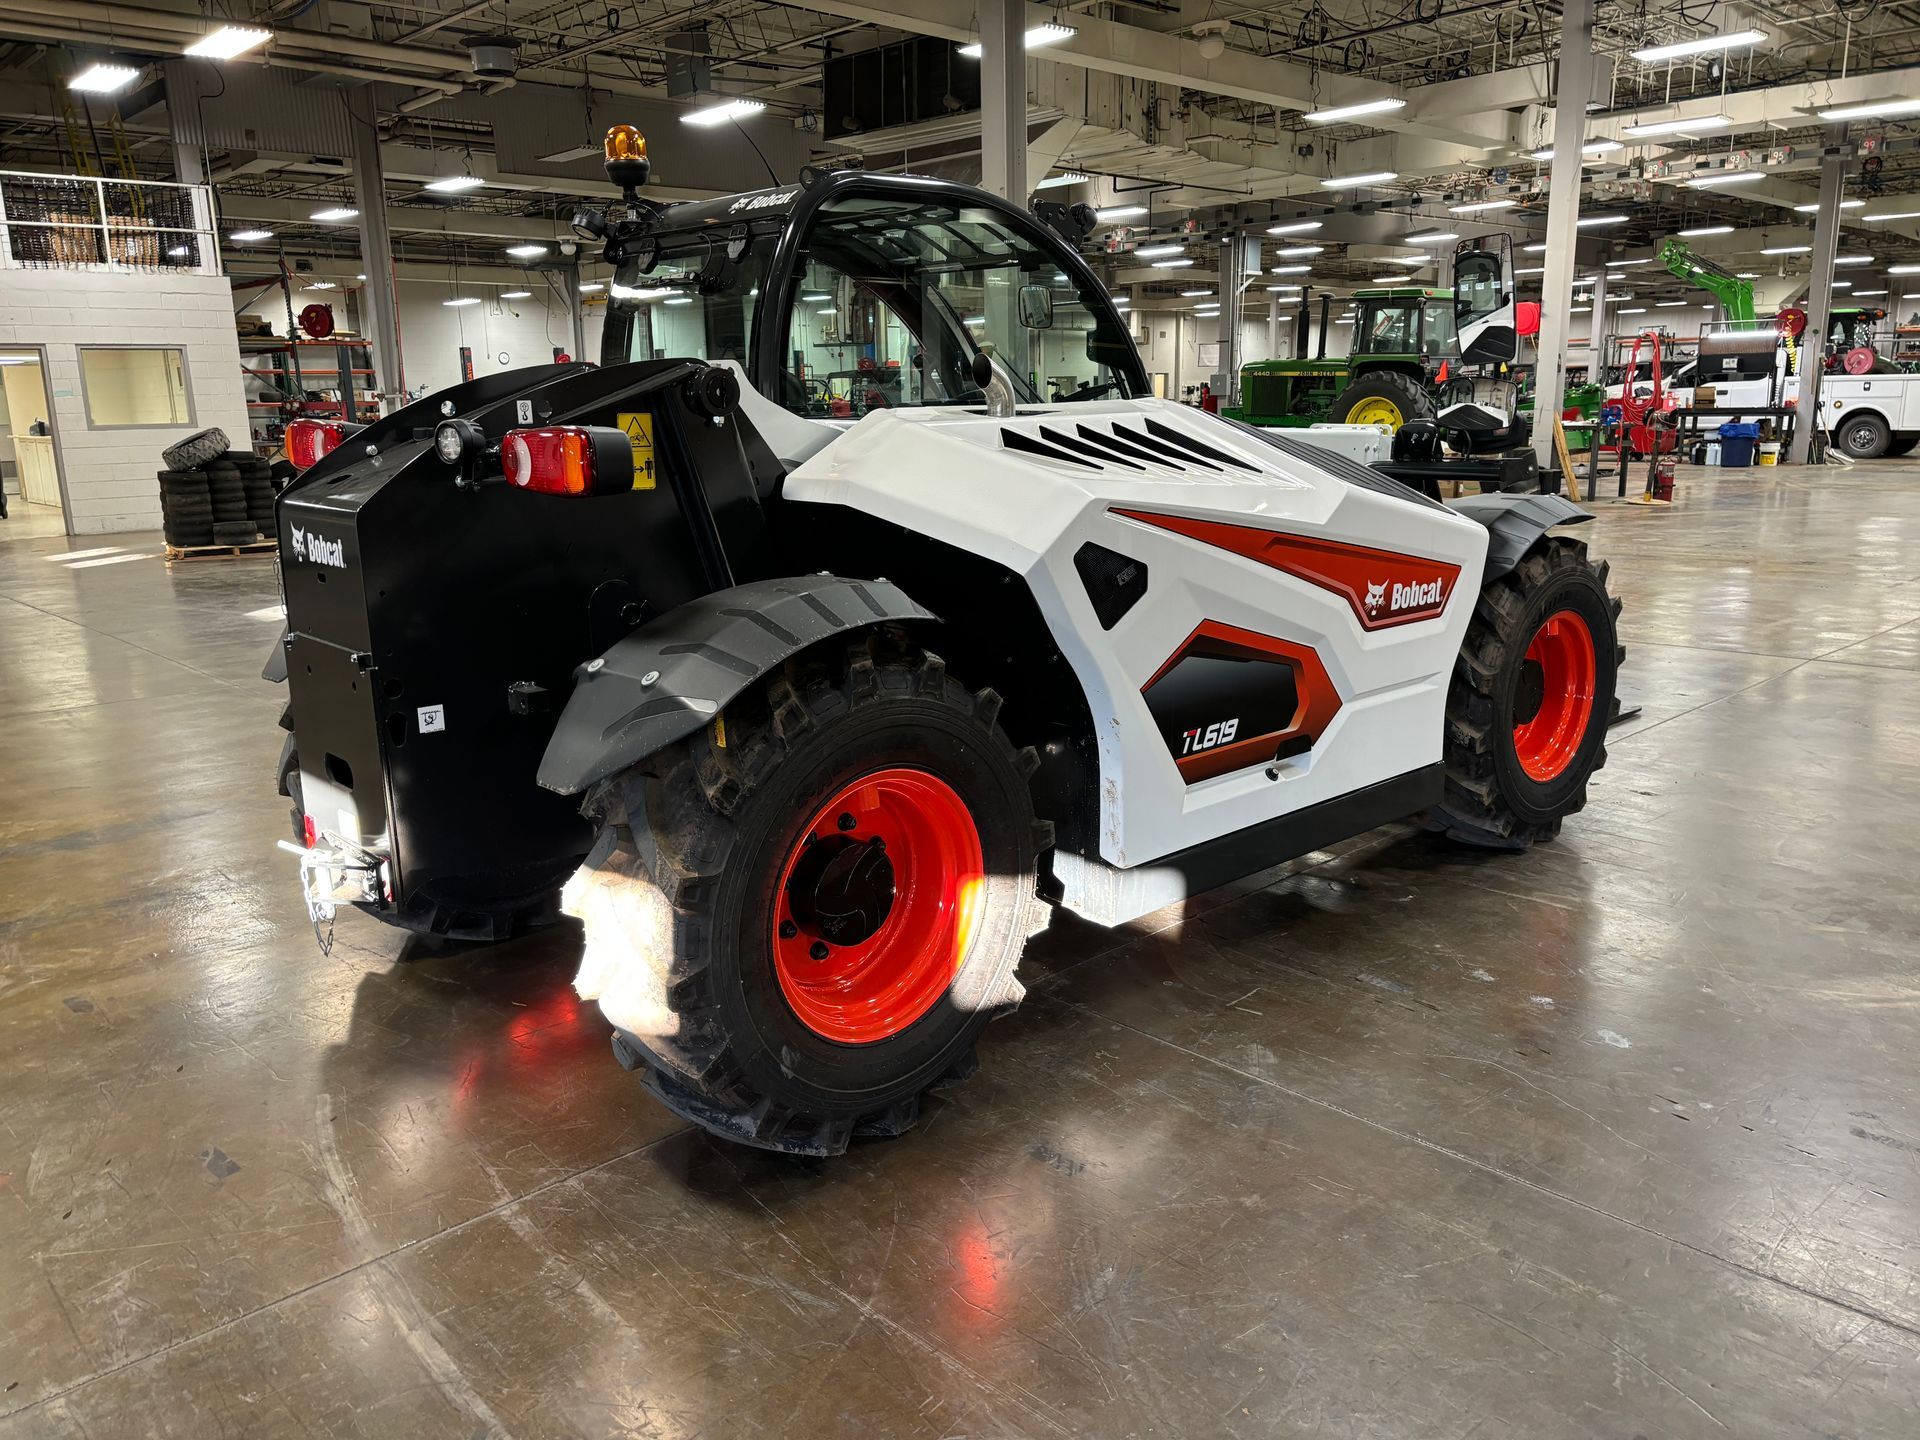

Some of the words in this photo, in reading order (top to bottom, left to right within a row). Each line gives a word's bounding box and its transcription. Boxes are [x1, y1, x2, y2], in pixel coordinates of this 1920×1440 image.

[745, 189, 799, 211] Bobcat
[306, 532, 345, 569] Bobcat
[1390, 576, 1443, 611] Bobcat
[1182, 718, 1239, 755] TL619
